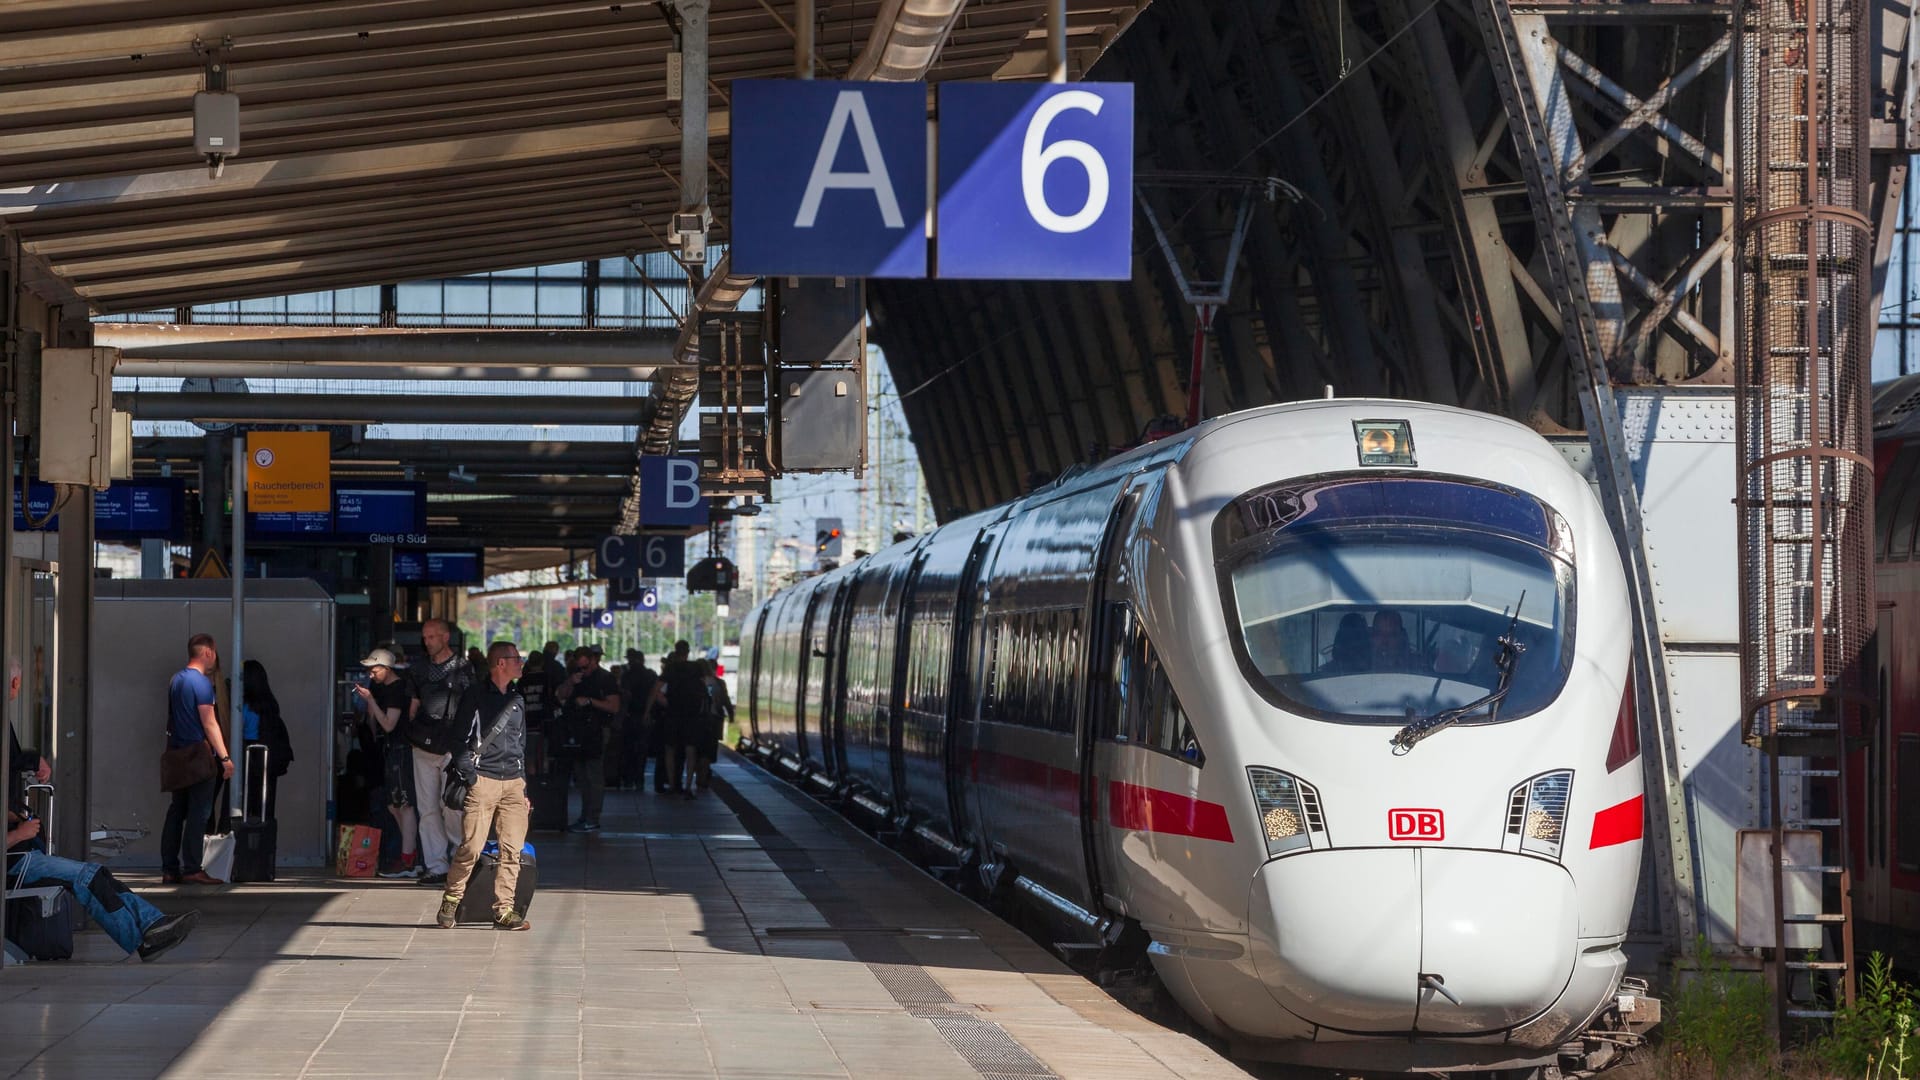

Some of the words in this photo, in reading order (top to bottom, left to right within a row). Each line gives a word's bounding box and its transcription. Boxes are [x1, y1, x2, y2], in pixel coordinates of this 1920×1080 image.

[793, 90, 905, 228] A
[1021, 90, 1109, 234] 6
[253, 481, 325, 491] Raucherbereich
[665, 459, 701, 509] B
[369, 533, 395, 543] Gleis
[397, 533, 404, 543] 6
[406, 533, 427, 544] Süd
[601, 535, 625, 568] C
[646, 535, 667, 568] 6
[579, 608, 589, 624] F
[1394, 812, 1440, 837] DB
